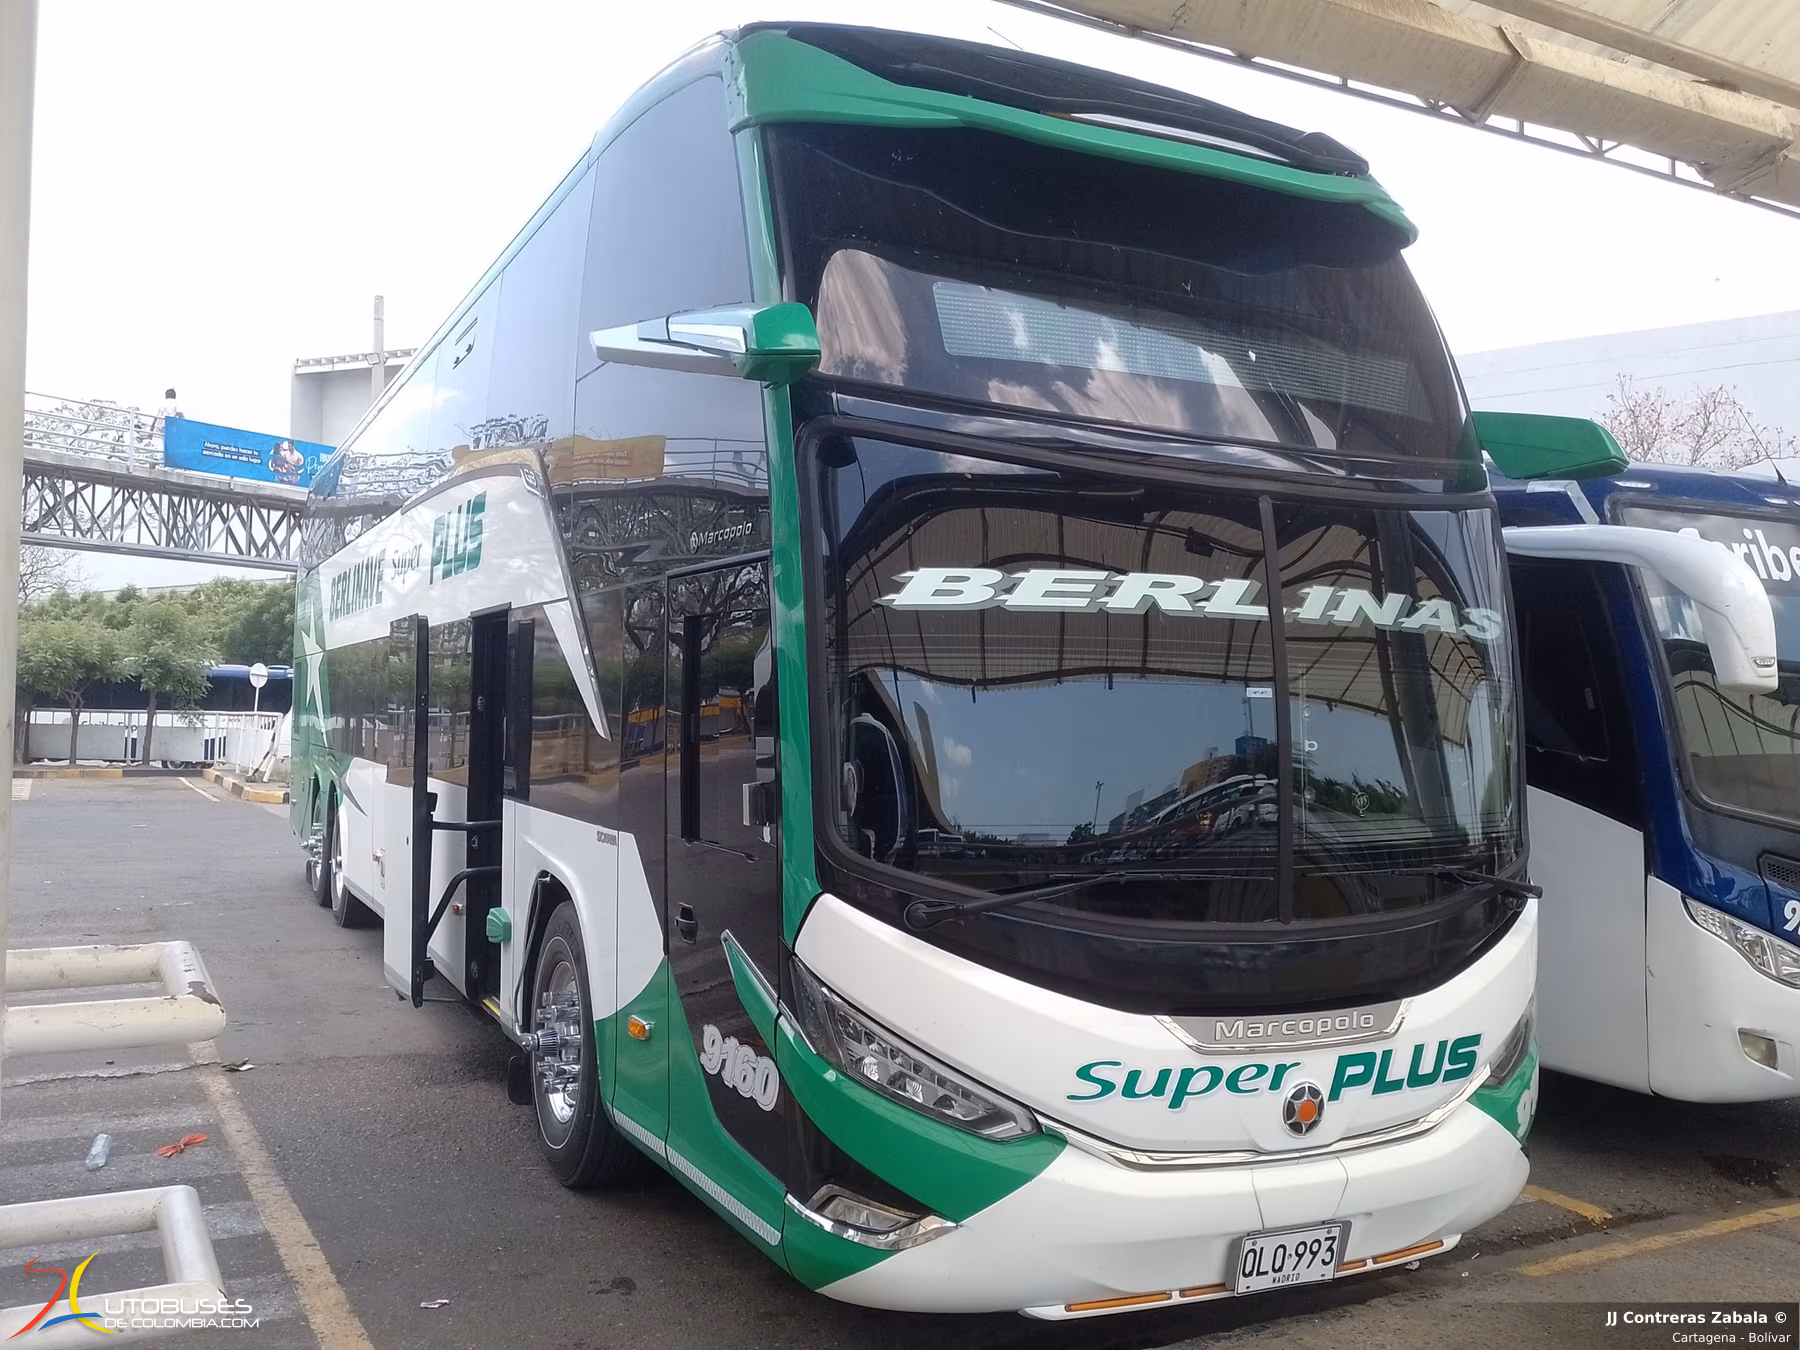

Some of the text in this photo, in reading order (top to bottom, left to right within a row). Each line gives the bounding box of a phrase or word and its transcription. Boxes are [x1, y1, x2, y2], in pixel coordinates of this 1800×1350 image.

[329, 547, 386, 623] BERLINAVE
[429, 489, 488, 586] PLUS
[698, 520, 753, 546] Marcopolo
[874, 565, 1504, 643] BERLINAS
[1213, 1010, 1376, 1043] Marcopolo
[699, 1023, 780, 1113] 9160
[1065, 1058, 1302, 1110] Super
[1327, 1032, 1484, 1103] PLUS
[1271, 1272, 1301, 1285] MADRID
